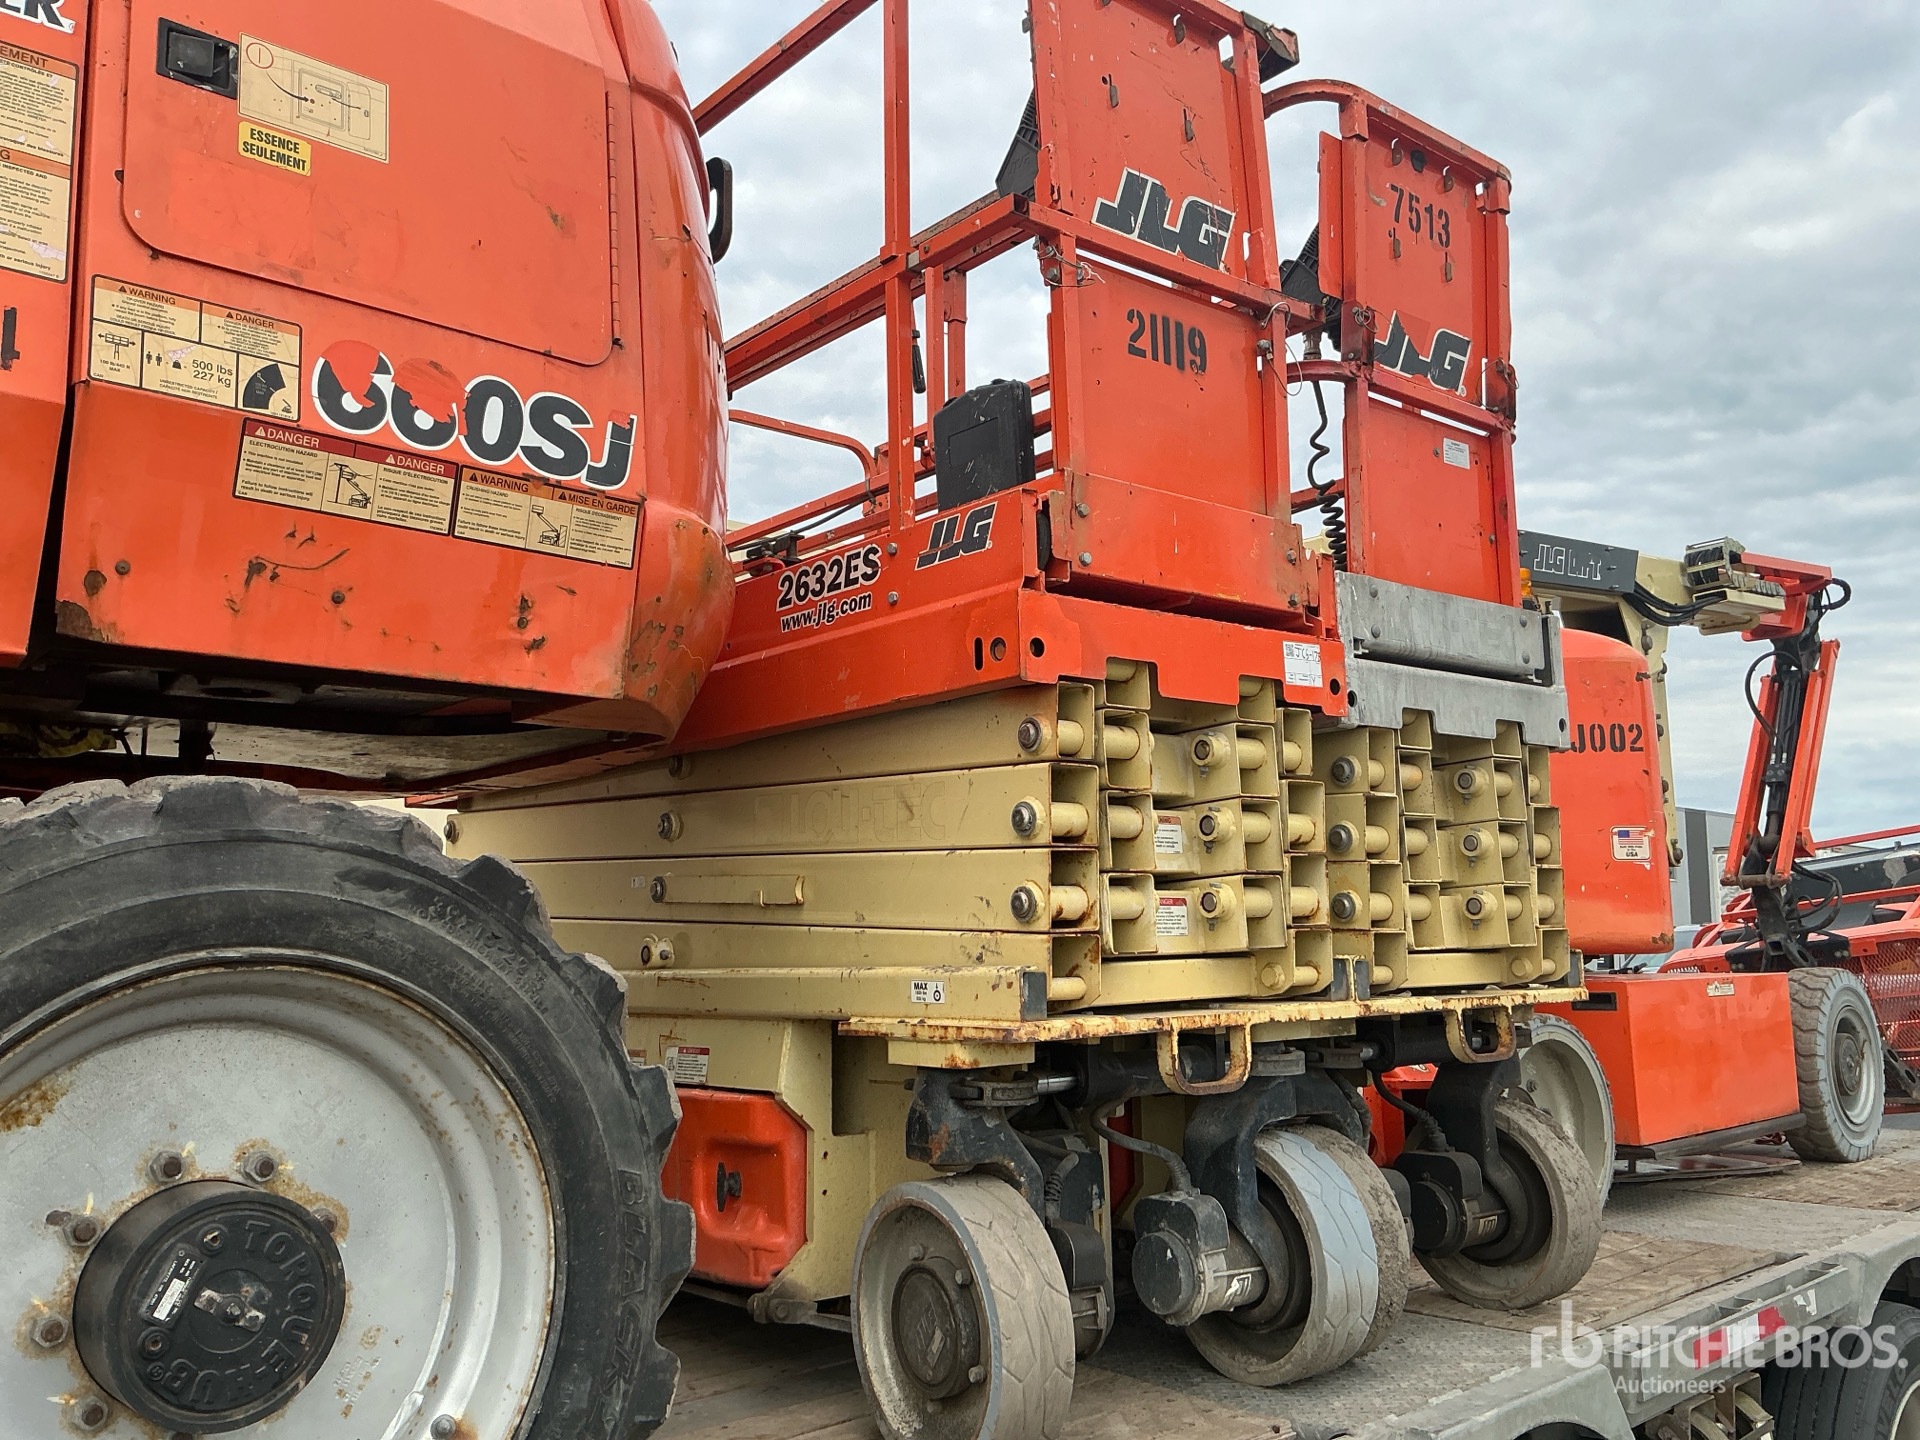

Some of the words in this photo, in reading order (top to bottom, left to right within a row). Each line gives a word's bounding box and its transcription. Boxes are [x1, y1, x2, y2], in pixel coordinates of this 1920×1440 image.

[250, 128, 300, 154] ESSENCE
[242, 141, 306, 171] SEULEMENT
[1091, 167, 1236, 274] JLG
[1390, 184, 1450, 248] 7513
[128, 287, 176, 305] WARNING
[236, 313, 274, 329] DANGER
[1127, 309, 1207, 375] 21119
[1374, 310, 1471, 393] JLG
[192, 360, 213, 371] 500
[217, 364, 233, 376] lbs
[193, 370, 214, 382] 227
[218, 375, 231, 388] kg
[249, 439, 294, 453] ELECTROCUTION
[295, 449, 317, 458] HAZARD
[267, 428, 319, 448] DANGER
[397, 455, 445, 475] DANGER
[480, 474, 529, 492] WARNING
[568, 493, 589, 506] MISE
[591, 498, 604, 509] EN
[606, 501, 635, 515] GARDE
[915, 501, 998, 570] JLG
[1534, 544, 1565, 574] JLG
[777, 545, 882, 610] 2632ES
[781, 592, 872, 632] www.jlg.com
[914, 982, 928, 990] MAX
